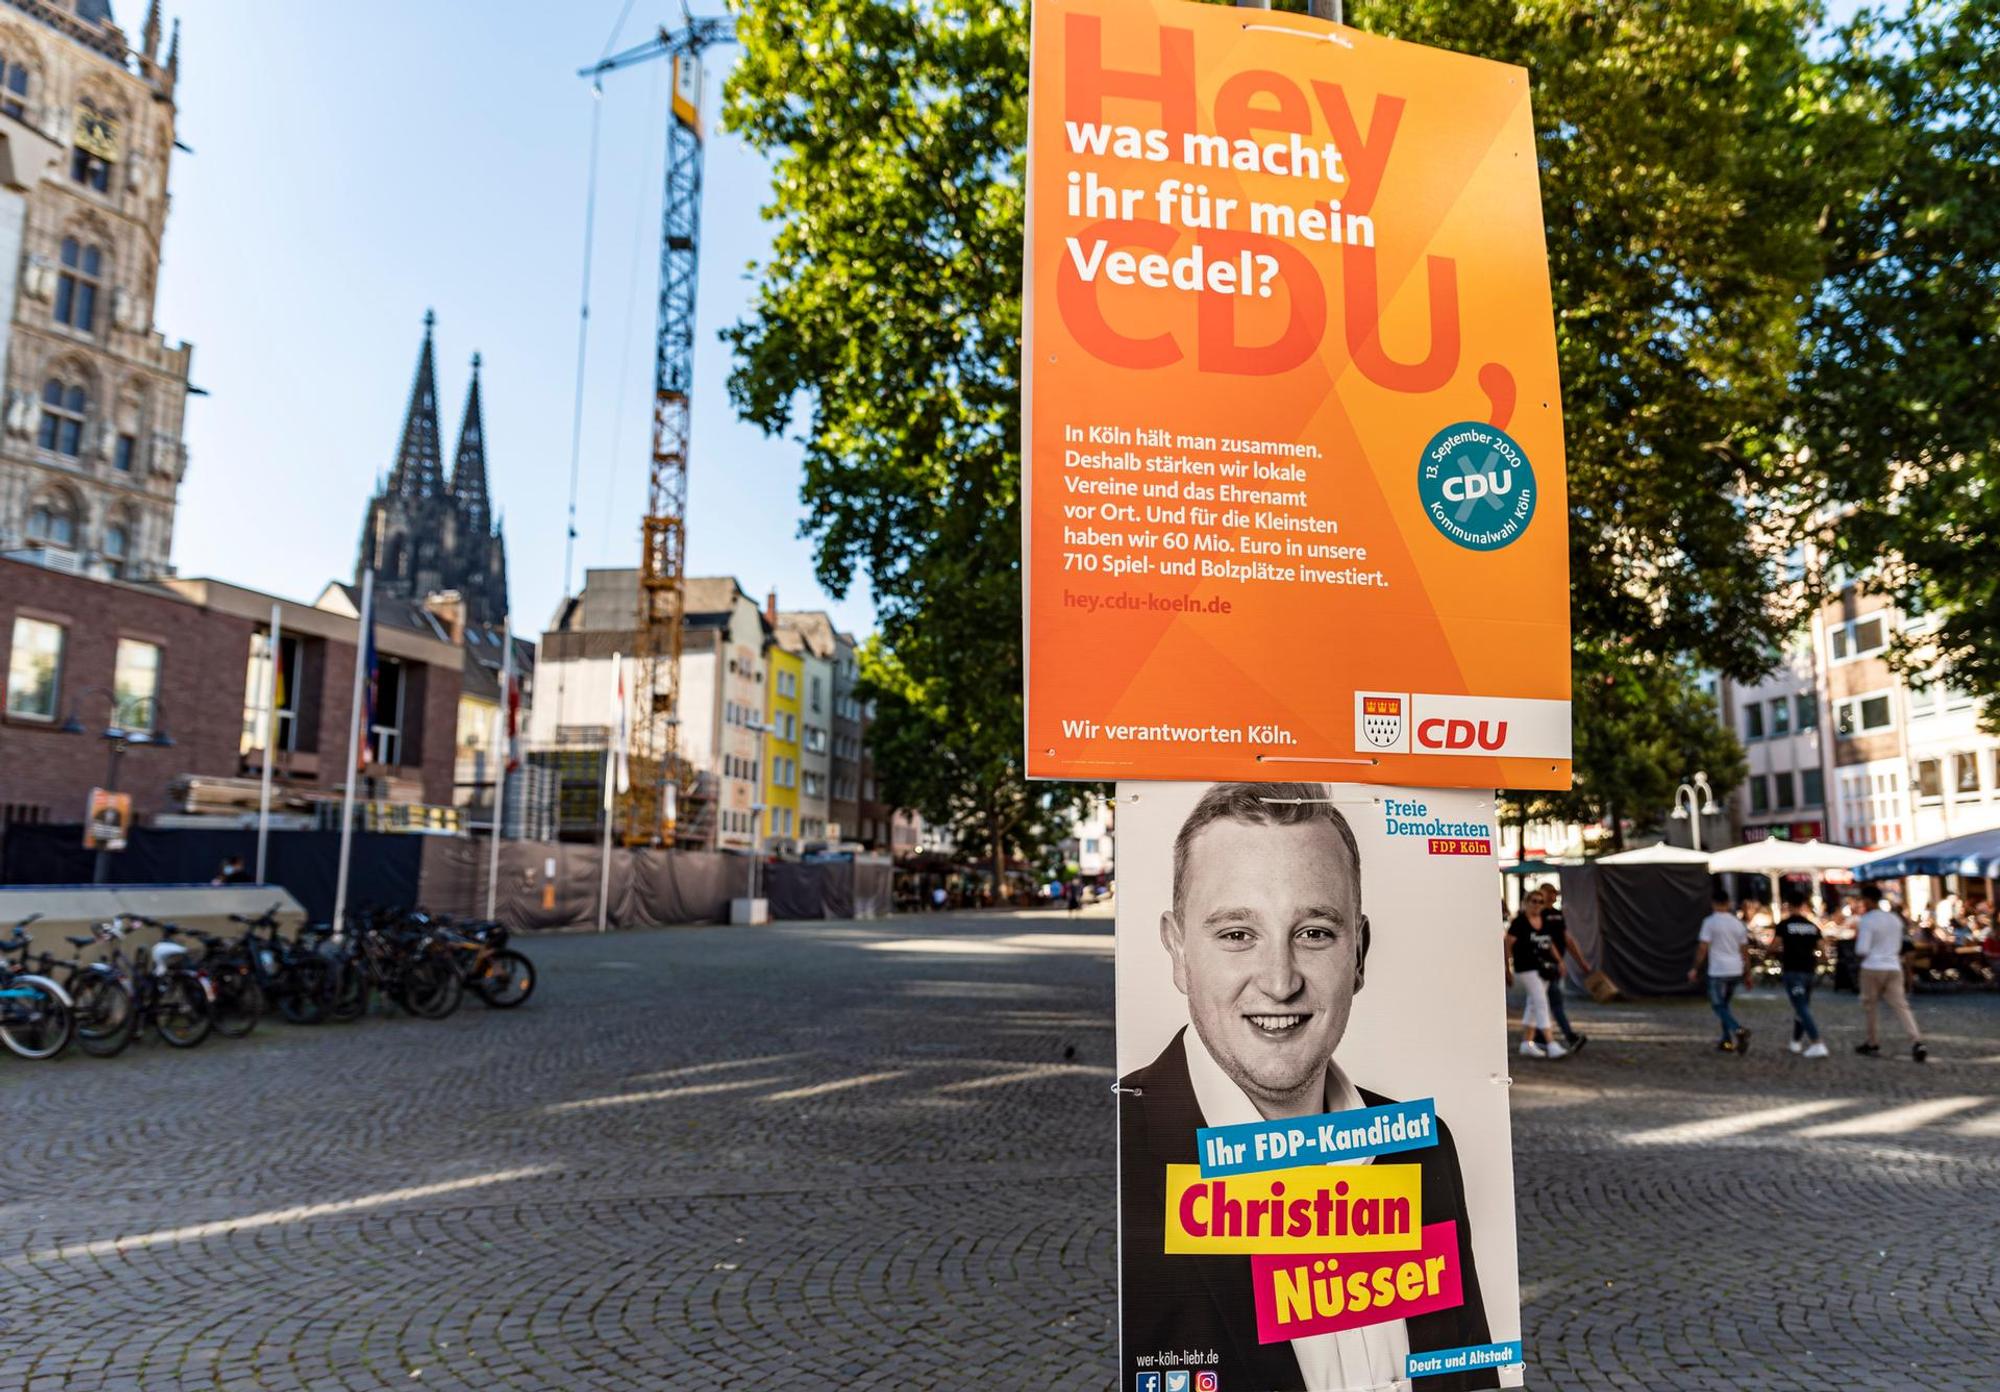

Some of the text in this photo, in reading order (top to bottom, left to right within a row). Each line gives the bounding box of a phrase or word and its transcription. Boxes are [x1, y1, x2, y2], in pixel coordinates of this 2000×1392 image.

[1065, 13, 1406, 229] Hey
[1065, 121, 1345, 184] was macht
[1067, 172, 1375, 248] ihr für mein
[1066, 237, 1280, 298] Veedel?
[1065, 425, 1322, 458] In Köln hält man zusammen.
[1426, 429, 1521, 479] 13. September 2020
[1065, 450, 1307, 481] Deshalb stärken wir lokale
[1064, 475, 1307, 507] Vereine und das Ehrenamt
[1442, 469, 1512, 502] CDU
[1064, 503, 1338, 533] vor Ort. Und für die Kleinsten
[1430, 489, 1531, 544] Kommunalwahl Köln
[1064, 526, 1366, 560] haben wir 60 Mio. Euro in unsere
[1063, 553, 1389, 587] 710 Spiel- und Bolzplätze investiert.
[1064, 589, 1231, 614] hey.cdu-koeln.de
[1062, 720, 1297, 745] Wir verantworten Köln.
[1417, 718, 1508, 750] CDU
[1384, 800, 1427, 817] Freie
[1386, 819, 1490, 837] Demokraten
[1432, 841, 1488, 853] FDP Köln
[1206, 1113, 1430, 1167] Ihr FDP-Kandidat
[1179, 1181, 1410, 1237] Christian
[1273, 1255, 1446, 1324] Nüsser
[1136, 1348, 1219, 1367] wer-köln-liebt.de
[1409, 1347, 1513, 1373] Deutz und Altstadt
